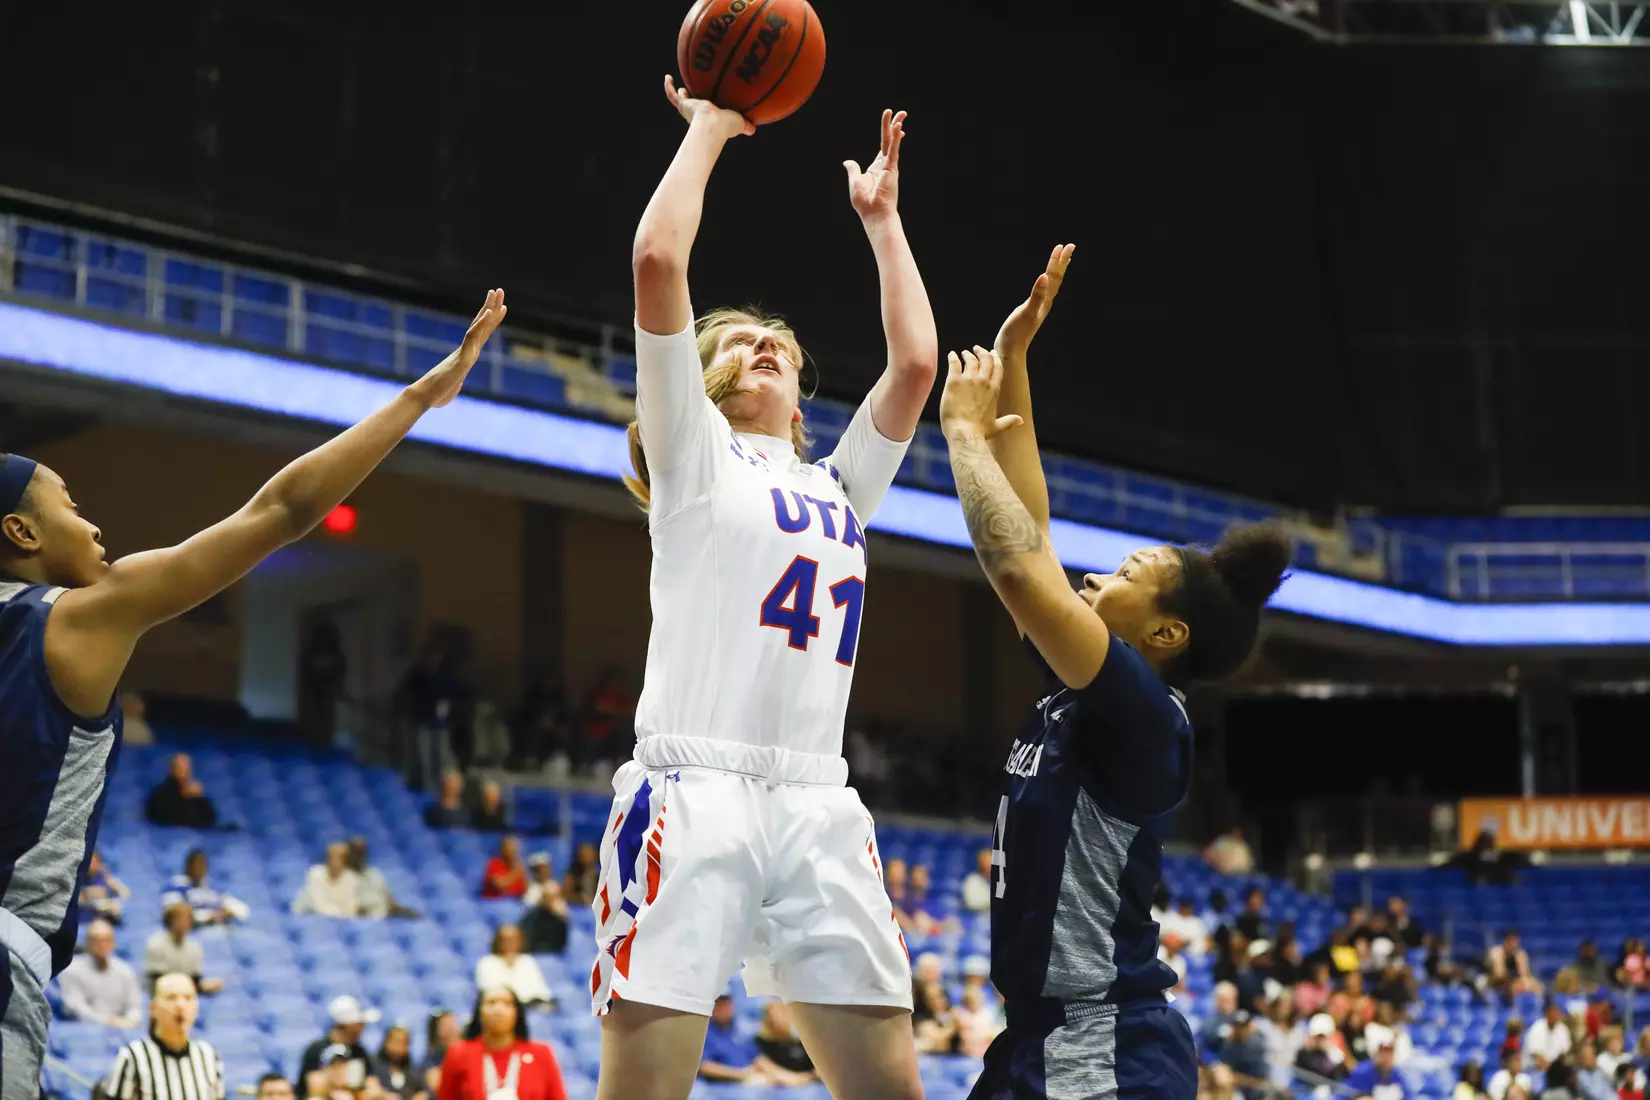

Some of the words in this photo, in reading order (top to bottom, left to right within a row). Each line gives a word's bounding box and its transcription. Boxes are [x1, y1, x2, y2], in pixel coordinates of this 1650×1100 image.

[693, 0, 757, 73] Wilso
[736, 12, 788, 85] NCAA
[759, 554, 865, 668] 41
[1508, 800, 1650, 843] UNIVE
